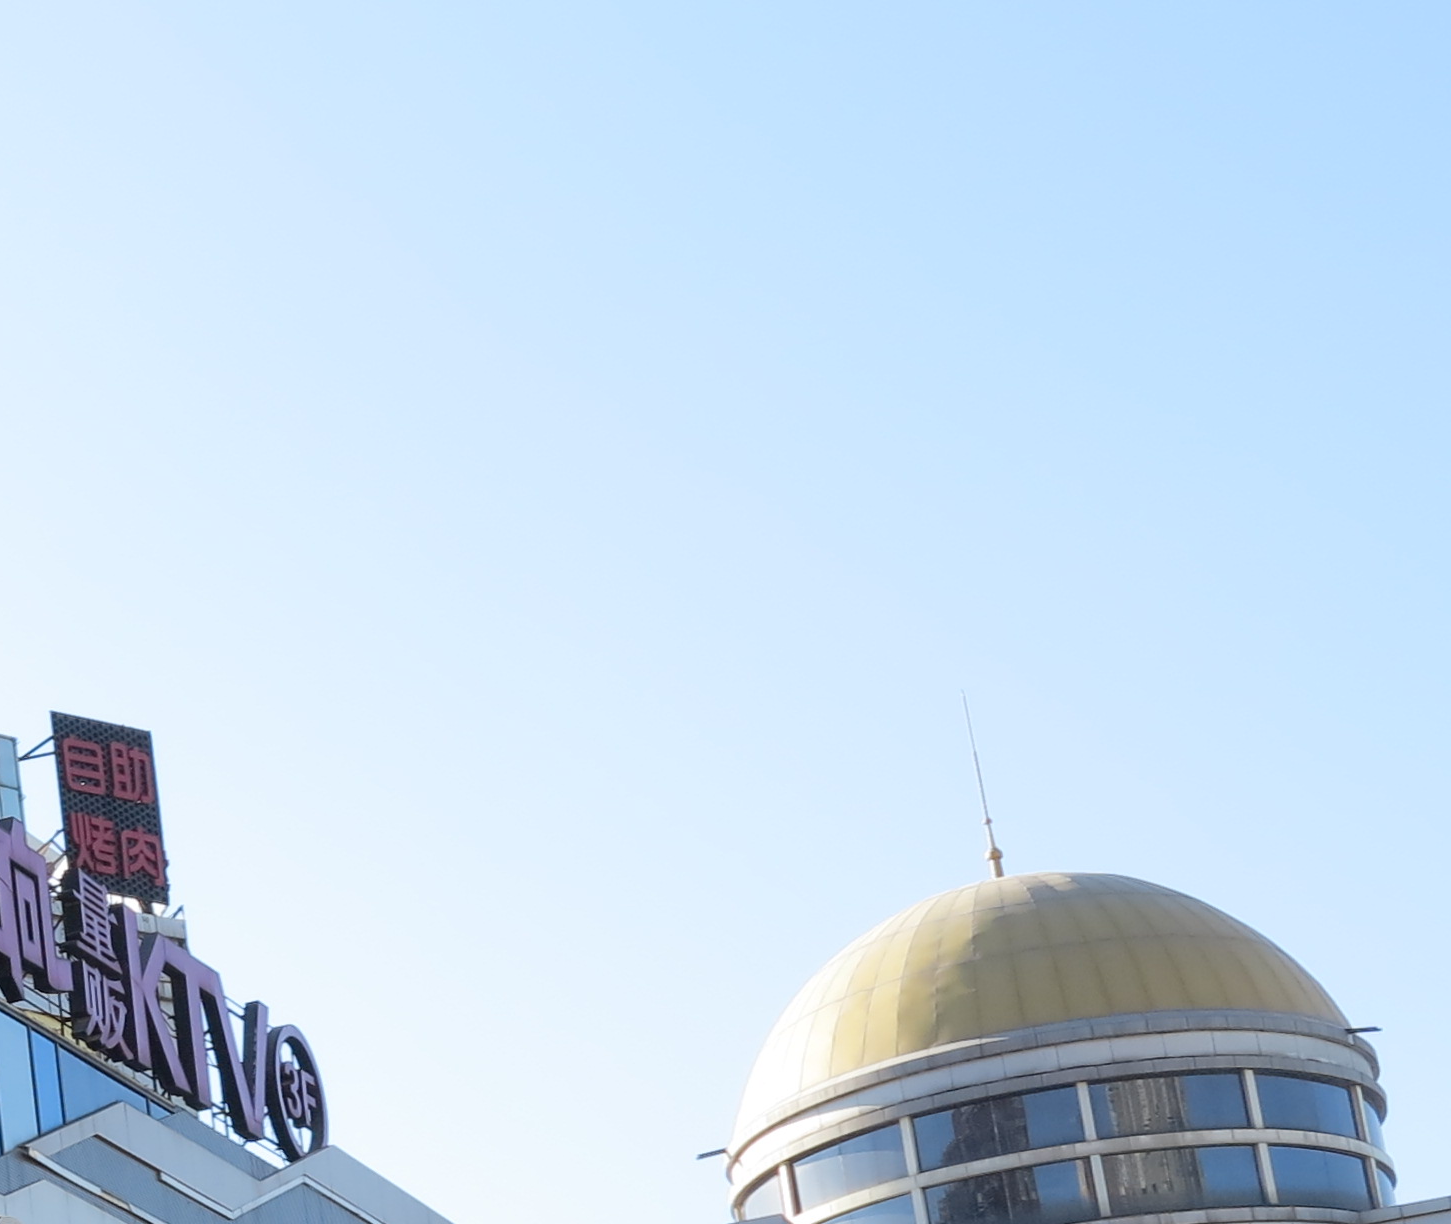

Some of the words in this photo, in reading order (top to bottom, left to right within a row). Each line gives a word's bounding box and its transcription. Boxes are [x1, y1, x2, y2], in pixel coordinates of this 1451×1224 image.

[61, 736, 155, 805] 自助
[68, 812, 167, 887] 烤肉
[72, 867, 135, 1060] 量贩
[117, 903, 271, 1142] KTV
